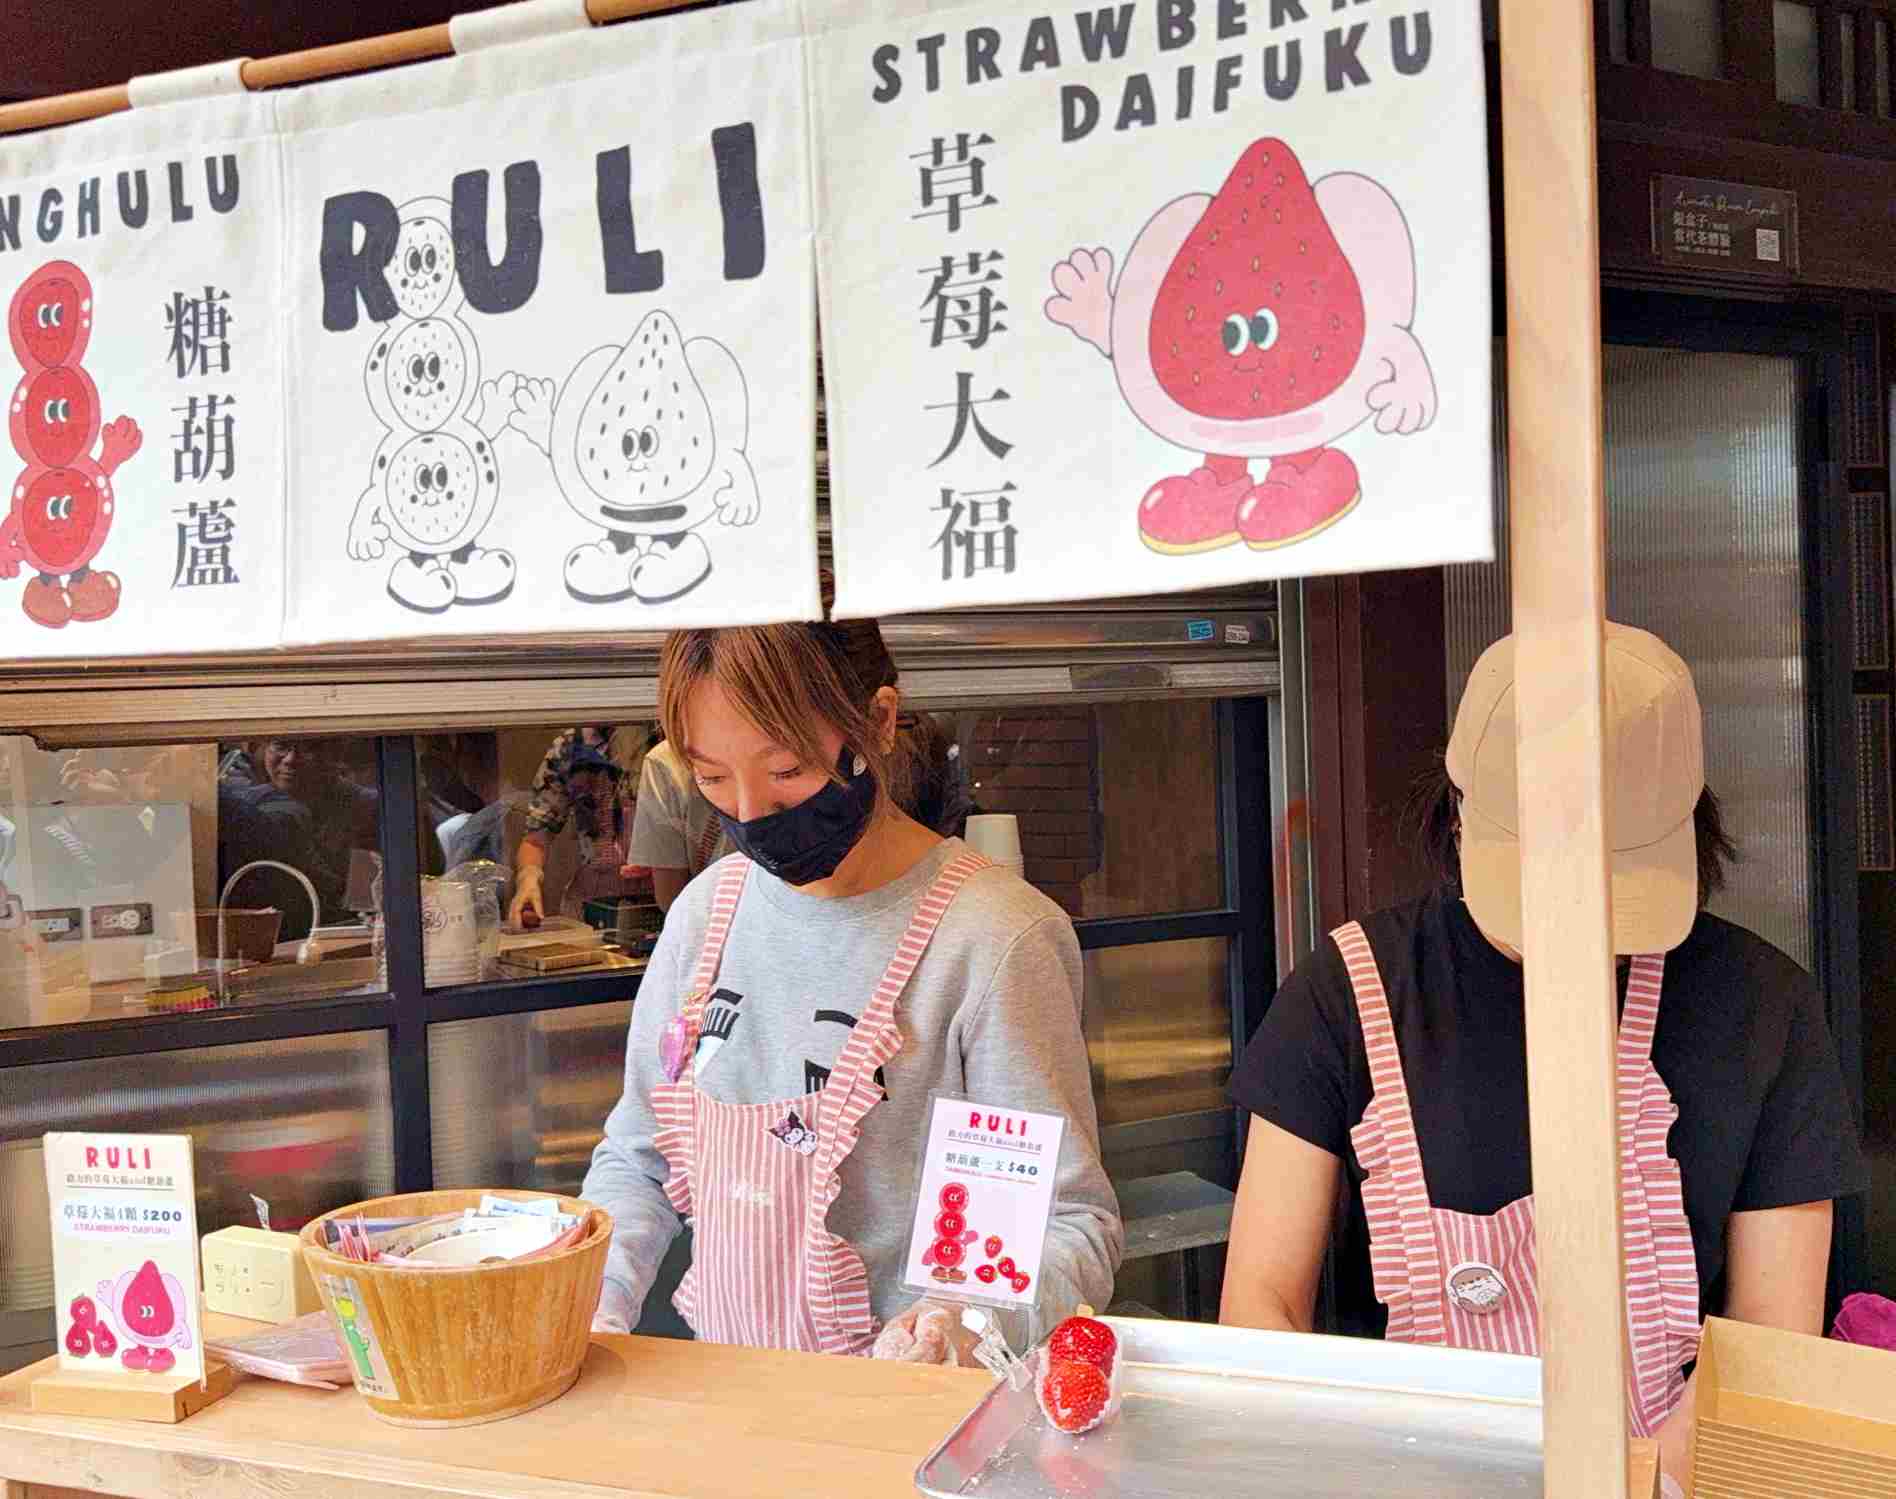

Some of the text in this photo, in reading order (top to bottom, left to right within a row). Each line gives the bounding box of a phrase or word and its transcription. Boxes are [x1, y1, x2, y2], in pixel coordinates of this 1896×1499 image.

[872, 0, 1371, 104] STRAWBER
[1060, 11, 1432, 142] DAIFUKU
[320, 121, 766, 331] RULI
[909, 132, 1020, 580] 草莓大福
[164, 286, 240, 590] 糖葫蘆
[85, 1146, 151, 1169] RULI
[968, 1111, 1028, 1136] RULI
[1007, 1161, 1038, 1176] $40
[143, 1209, 182, 1222] $200
